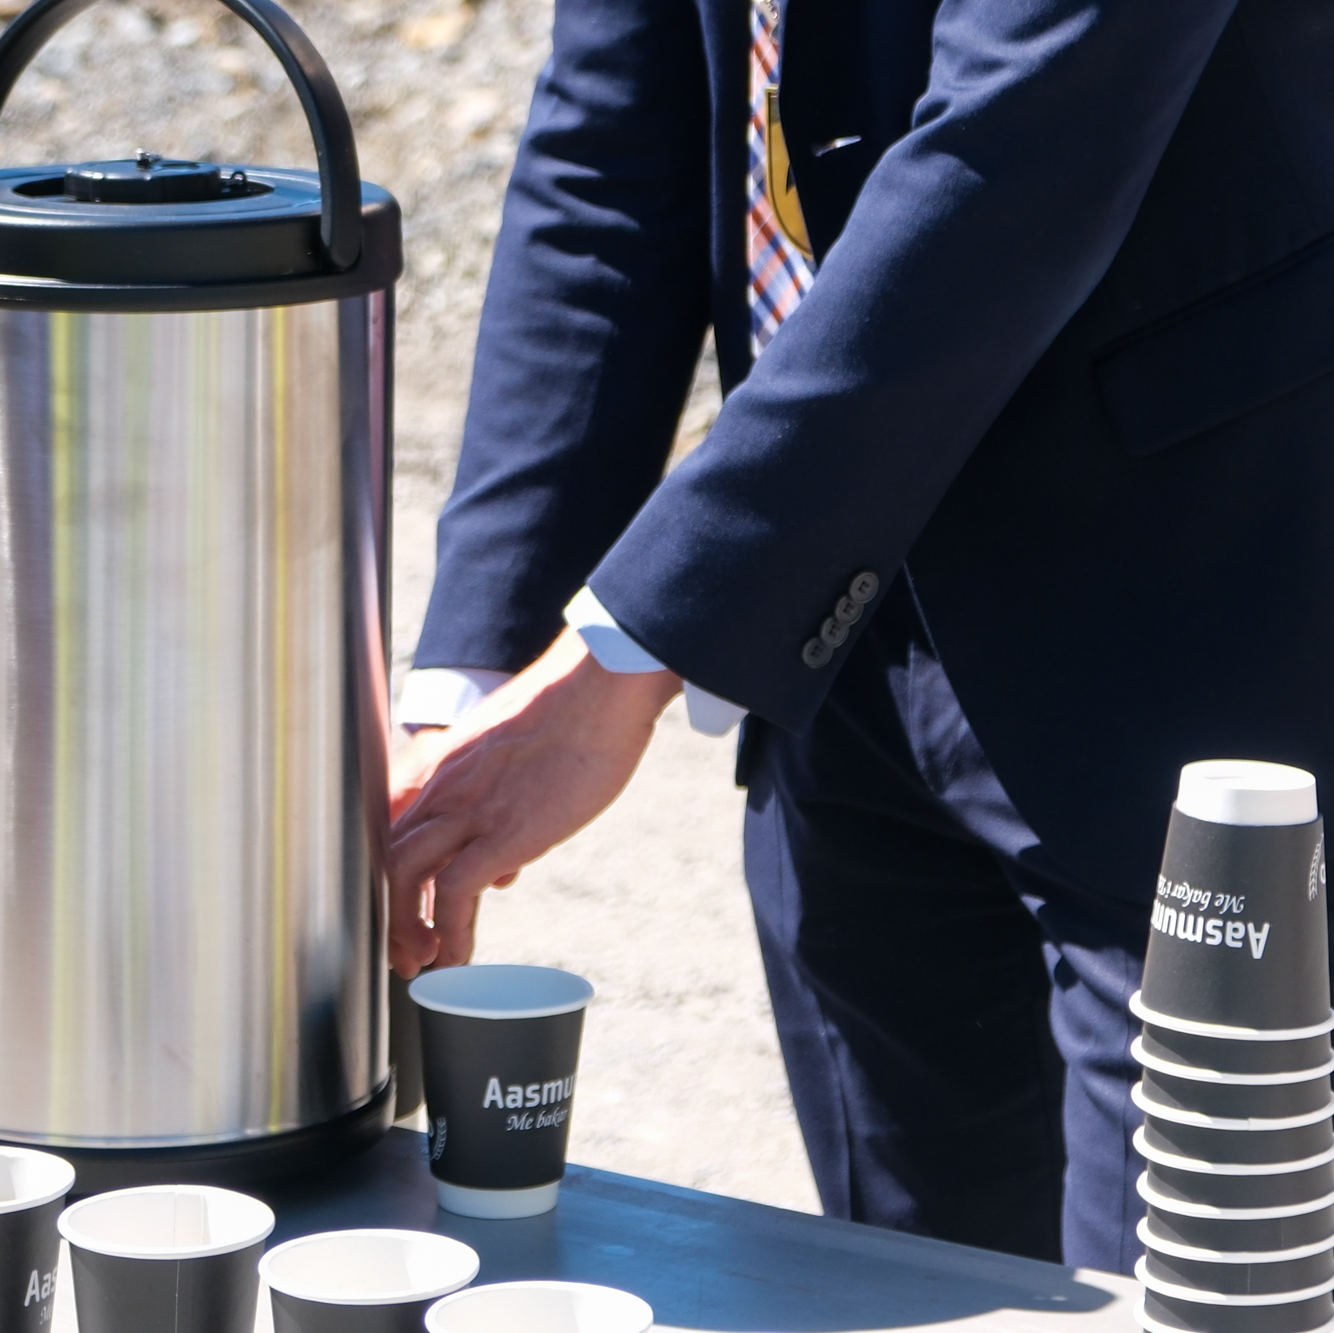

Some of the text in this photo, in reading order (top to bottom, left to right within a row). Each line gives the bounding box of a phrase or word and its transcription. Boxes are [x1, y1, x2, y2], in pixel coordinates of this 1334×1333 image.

[1171, 881, 1212, 911] bakar
[1215, 894, 1245, 914] Me
[507, 1113, 533, 1131] Me
